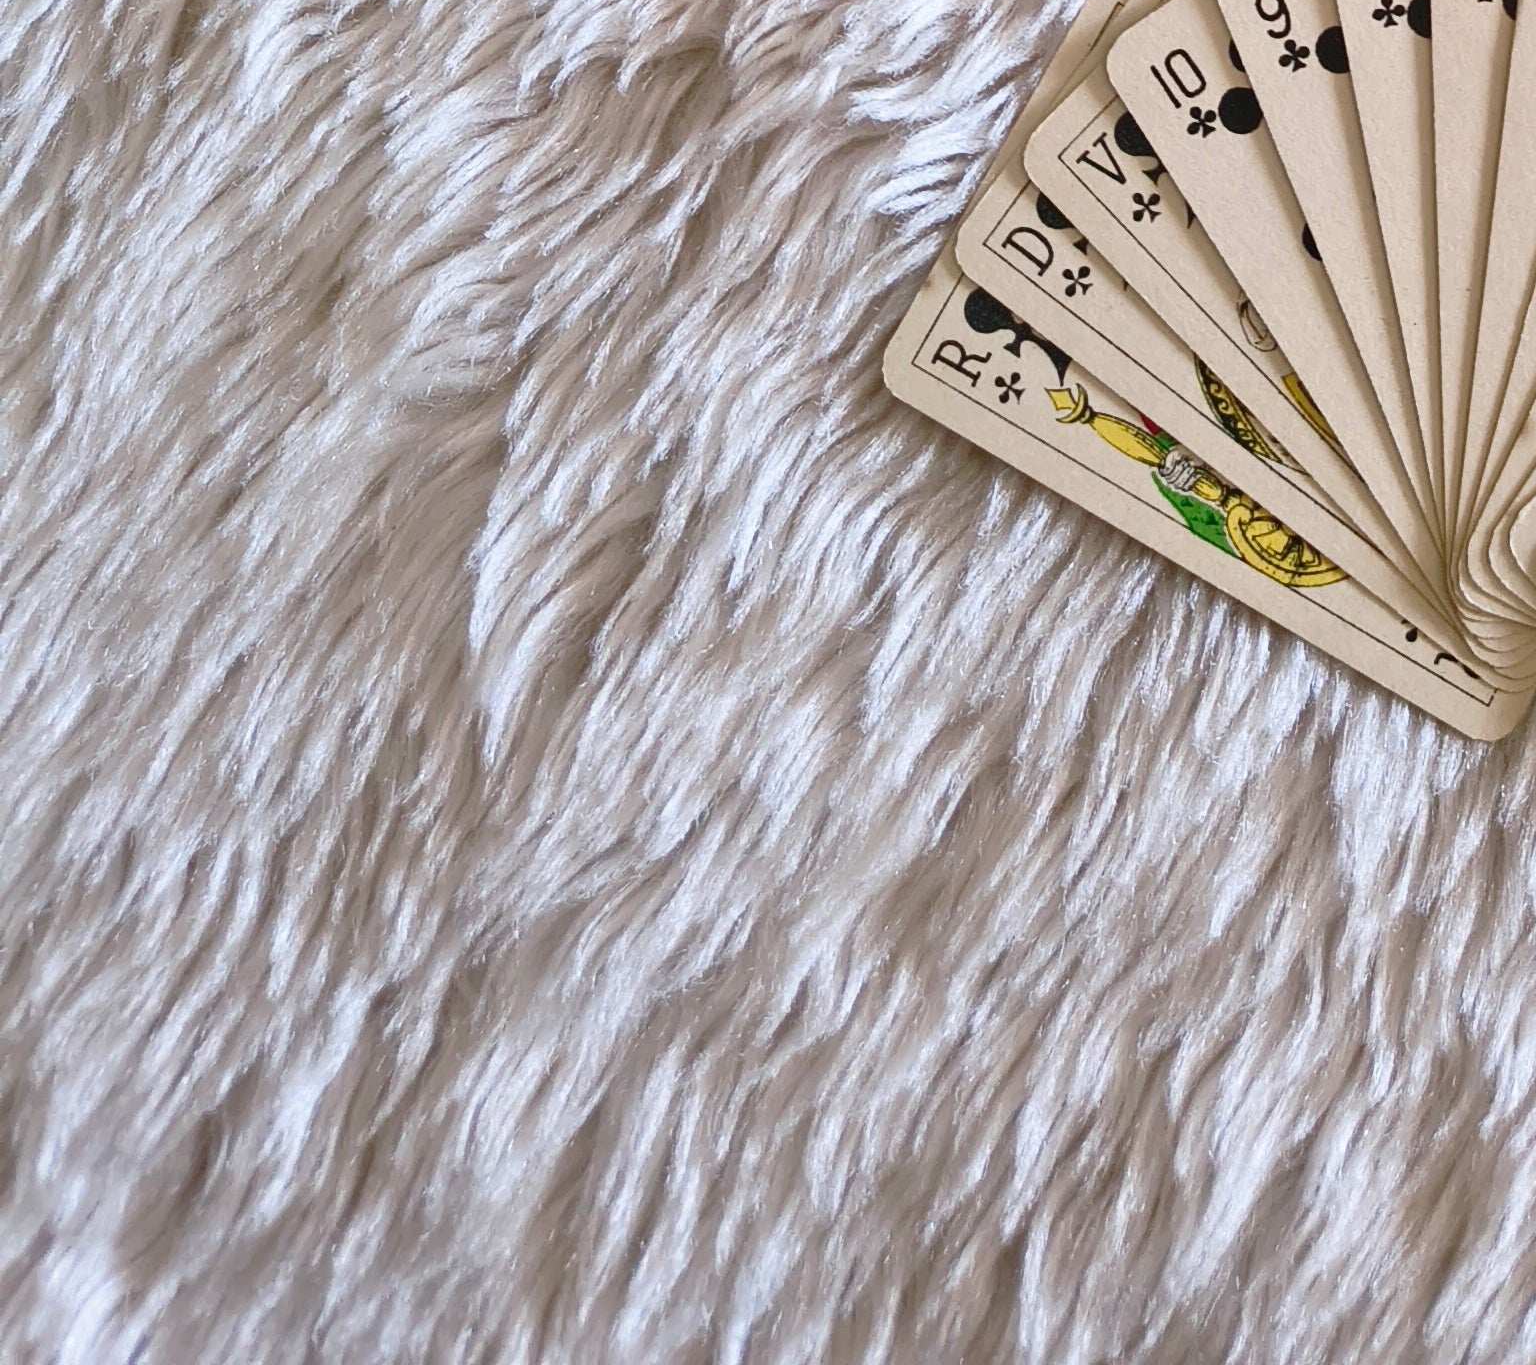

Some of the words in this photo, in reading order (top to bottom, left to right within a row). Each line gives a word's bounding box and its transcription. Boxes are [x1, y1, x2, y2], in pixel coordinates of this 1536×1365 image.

[1150, 48, 1207, 110] 10
[1075, 132, 1127, 185] V
[1001, 226, 1054, 277] D
[931, 339, 993, 388] R
